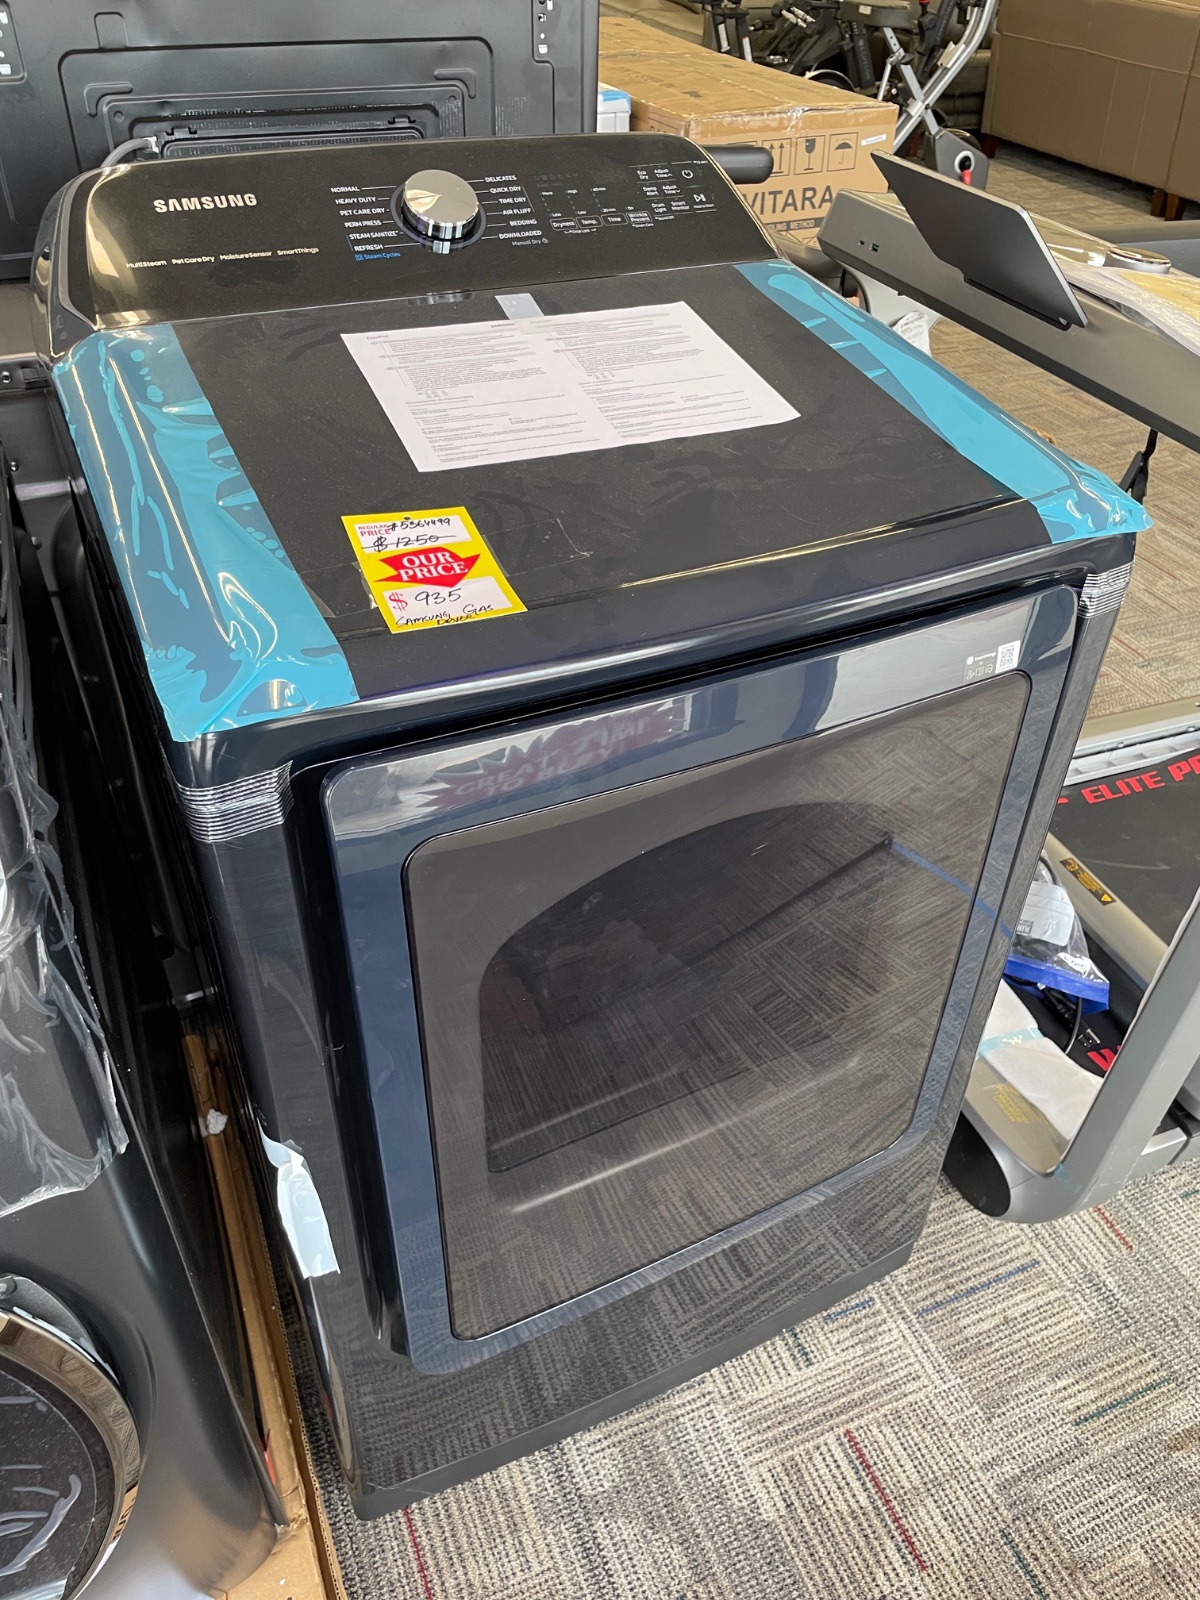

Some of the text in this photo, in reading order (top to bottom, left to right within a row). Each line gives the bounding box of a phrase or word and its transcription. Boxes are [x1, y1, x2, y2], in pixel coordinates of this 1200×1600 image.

[484, 174, 517, 183] DELICATES
[153, 193, 258, 213] SAMSUNG
[335, 197, 358, 205] HEAVY
[513, 207, 532, 215] FLUFF
[362, 219, 382, 227] PRESS
[509, 218, 538, 227] BEDDING
[349, 232, 371, 240] STEAM
[498, 230, 542, 239] DOWNLOADED
[354, 244, 384, 252] REFRESH
[382, 251, 401, 259] Cycles
[360, 528, 391, 537] PRICE
[402, 551, 454, 568] OUR
[397, 561, 468, 582] PRICE
[388, 588, 462, 612] $ 935
[1081, 771, 1166, 804] ELITE
